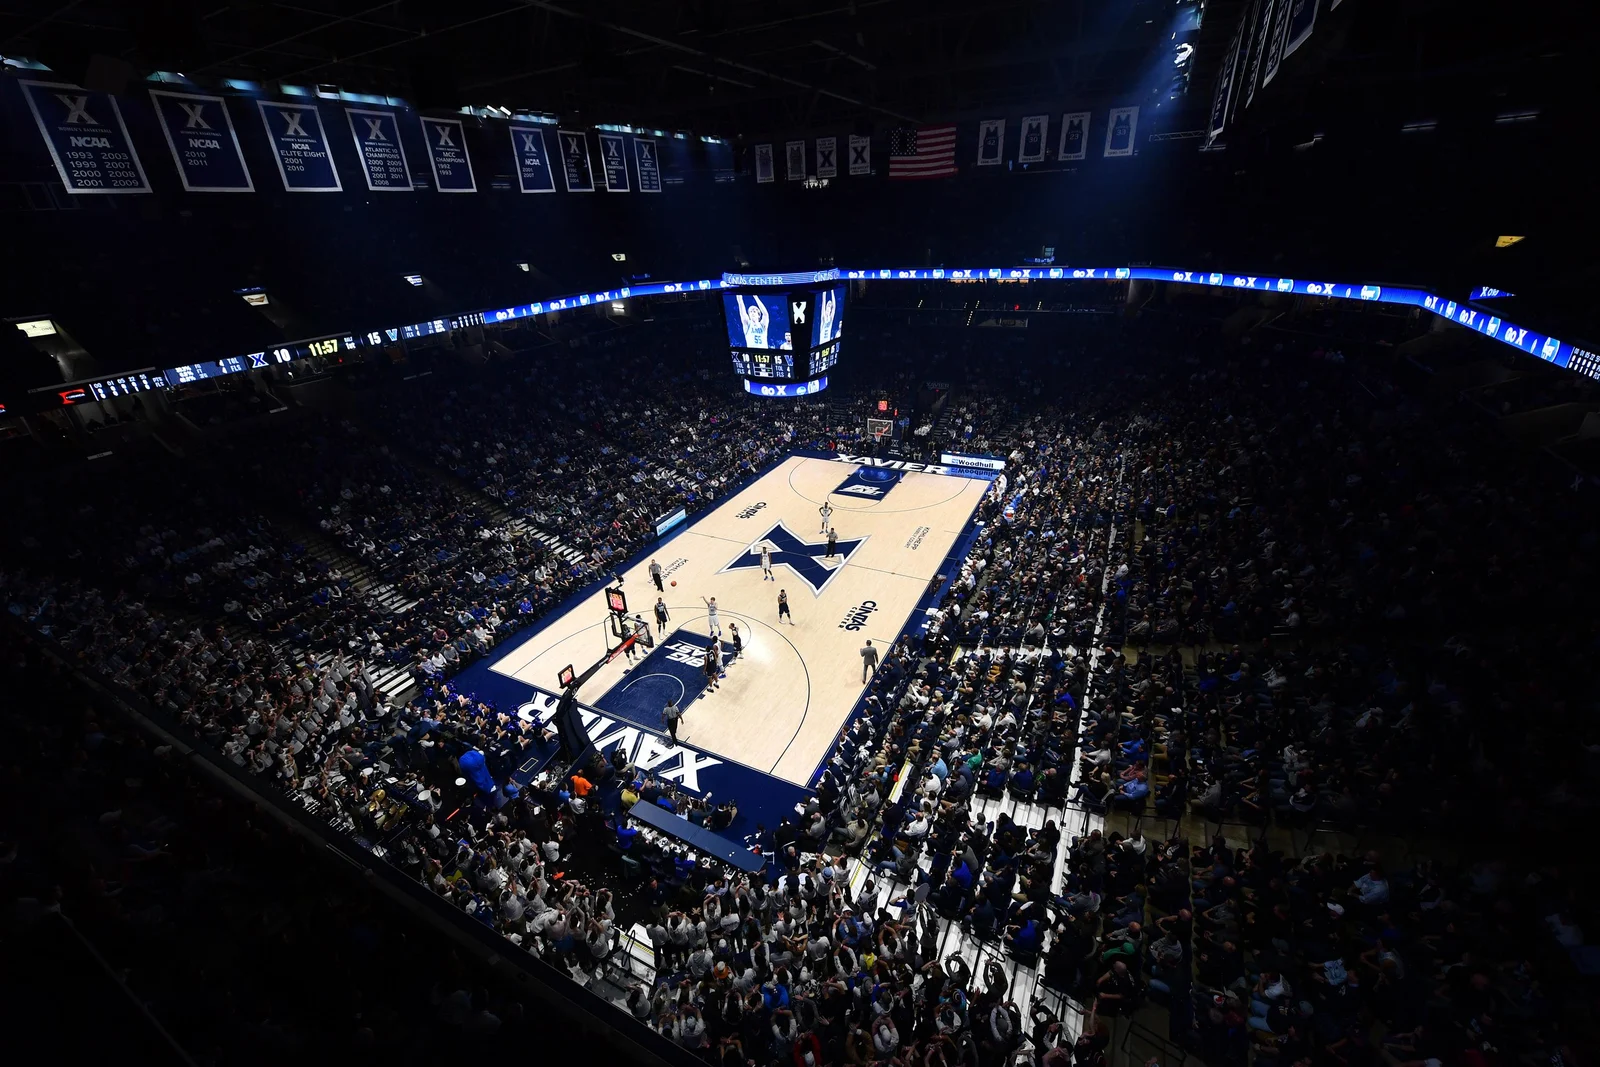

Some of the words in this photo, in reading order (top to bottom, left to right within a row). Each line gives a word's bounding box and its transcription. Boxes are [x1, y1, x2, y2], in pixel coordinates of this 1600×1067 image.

[53, 94, 98, 124] X
[177, 102, 214, 130] X
[279, 111, 312, 137] X
[363, 118, 388, 140] X
[70, 136, 110, 148] NCAA
[434, 125, 456, 146] X
[521, 134, 538, 152] X
[189, 139, 221, 149] NCAA
[568, 137, 582, 154] X
[607, 140, 619, 157] X
[641, 144, 651, 159] X
[66, 152, 94, 160] 1993
[100, 152, 128, 160] 2003
[819, 150, 833, 168] X
[852, 146, 867, 164] X
[748, 276, 784, 285] CENTER
[908, 270, 916, 278] X
[963, 270, 972, 278] X
[1085, 269, 1096, 278] X
[1184, 272, 1193, 281] X
[1246, 277, 1257, 287] X
[1322, 283, 1336, 295] X
[1432, 297, 1439, 310] X
[792, 301, 806, 324] X
[1468, 310, 1477, 326] X
[367, 332, 382, 345] 15
[385, 328, 398, 342] V
[1515, 328, 1528, 346] X
[273, 348, 291, 363] 10
[308, 339, 338, 357] 11:57
[247, 352, 269, 368] X
[754, 355, 770, 363] 11:57
[774, 356, 782, 364] 15
[761, 386, 775, 396] Go
[775, 385, 787, 396] X
[830, 453, 949, 474] XAVIER
[958, 458, 994, 468] Woodhull
[838, 607, 857, 628] CENTER
[845, 600, 878, 631] CINTAS
[665, 652, 704, 668] BIG
